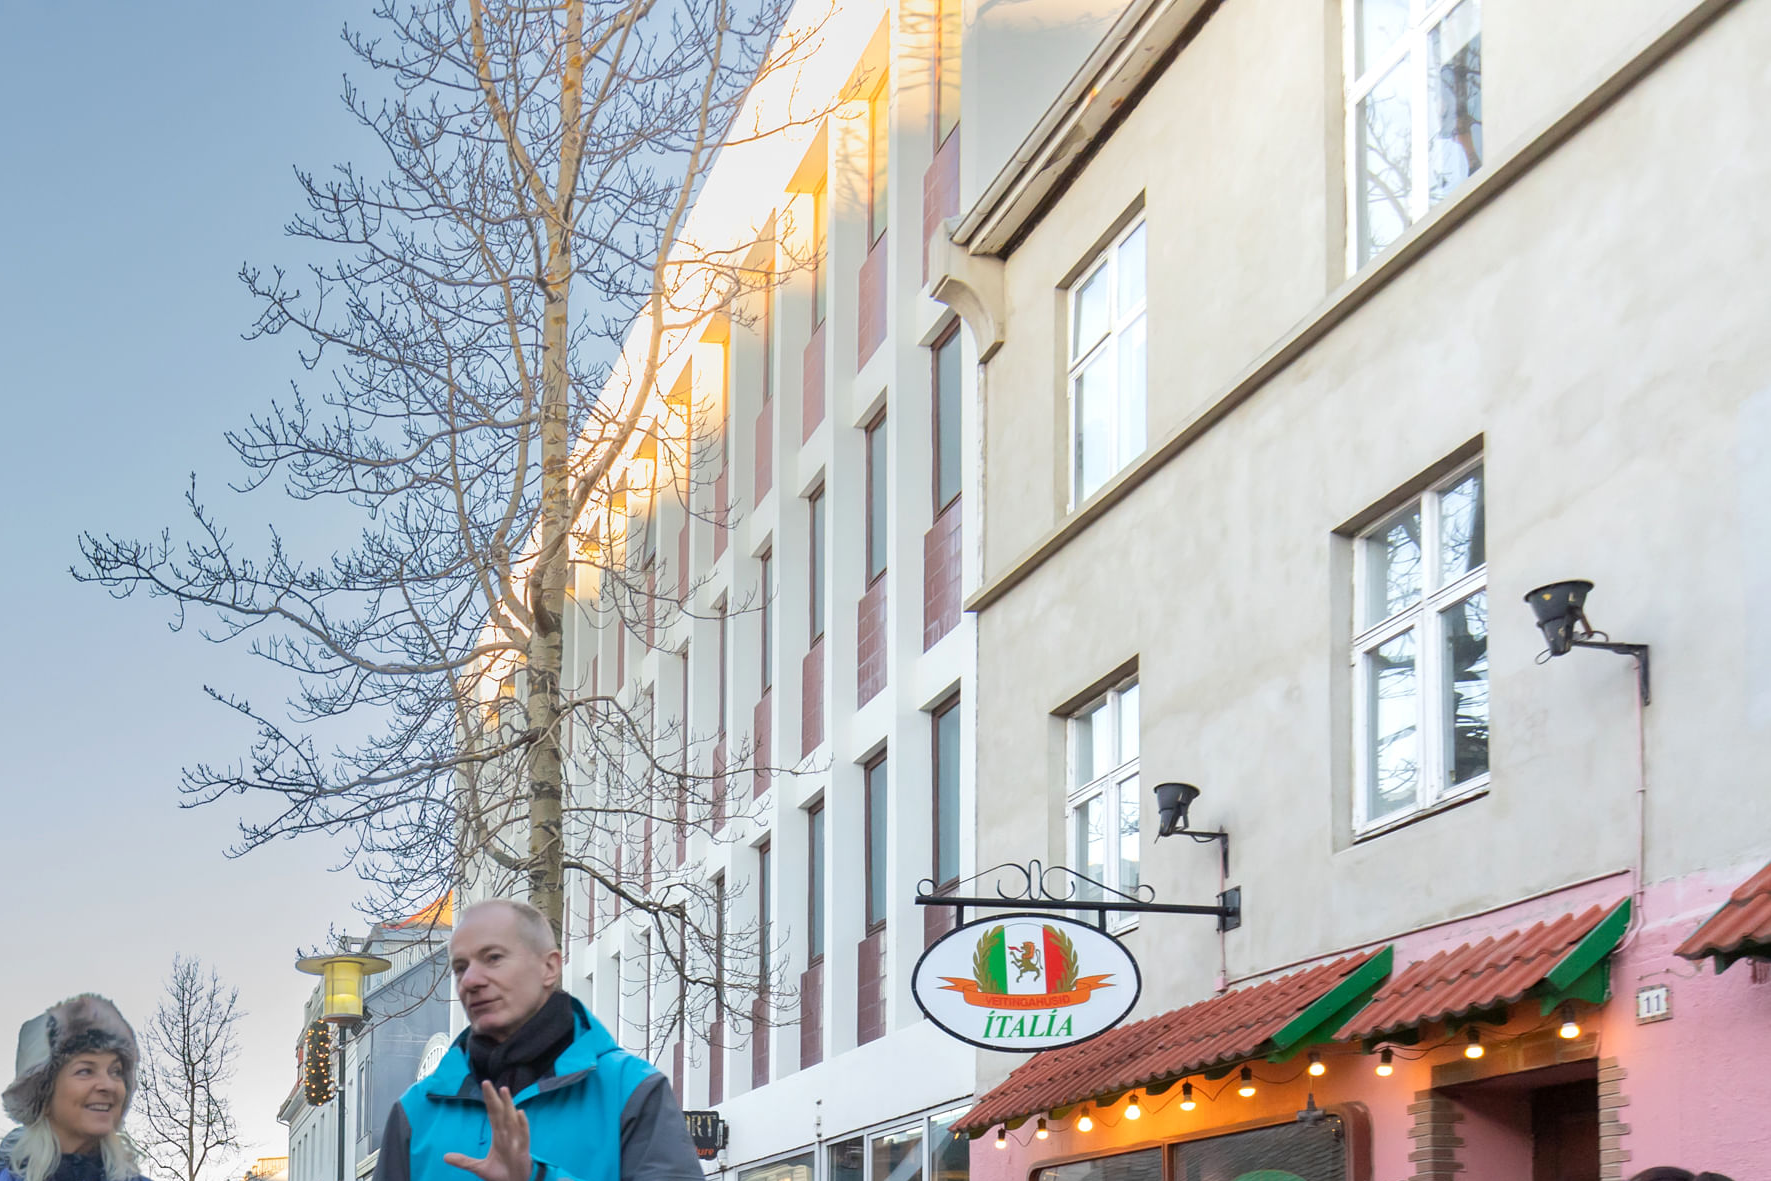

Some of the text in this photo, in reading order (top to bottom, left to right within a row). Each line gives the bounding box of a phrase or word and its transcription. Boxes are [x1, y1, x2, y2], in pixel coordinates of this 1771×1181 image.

[1644, 994, 1661, 1014] 11
[983, 1009, 1073, 1038] ÍTALÍA
[695, 1146, 714, 1156] ure
